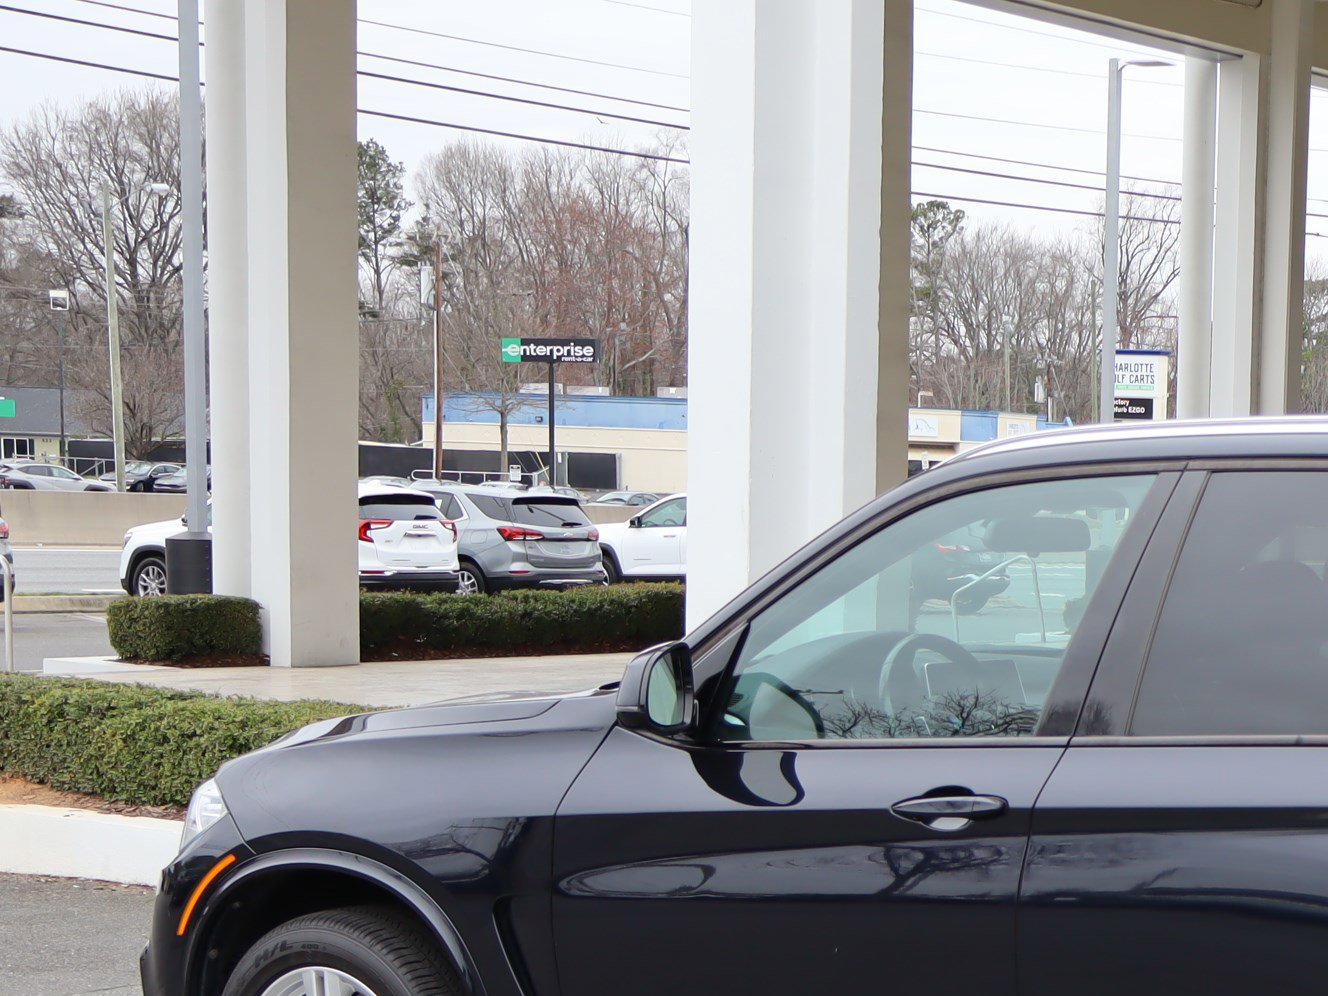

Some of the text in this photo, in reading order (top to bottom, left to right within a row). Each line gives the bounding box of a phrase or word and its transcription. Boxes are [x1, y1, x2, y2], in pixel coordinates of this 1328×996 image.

[507, 342, 594, 360] enterprise
[1115, 363, 1154, 373] HARLOTTE
[1129, 374, 1155, 384] CARTS
